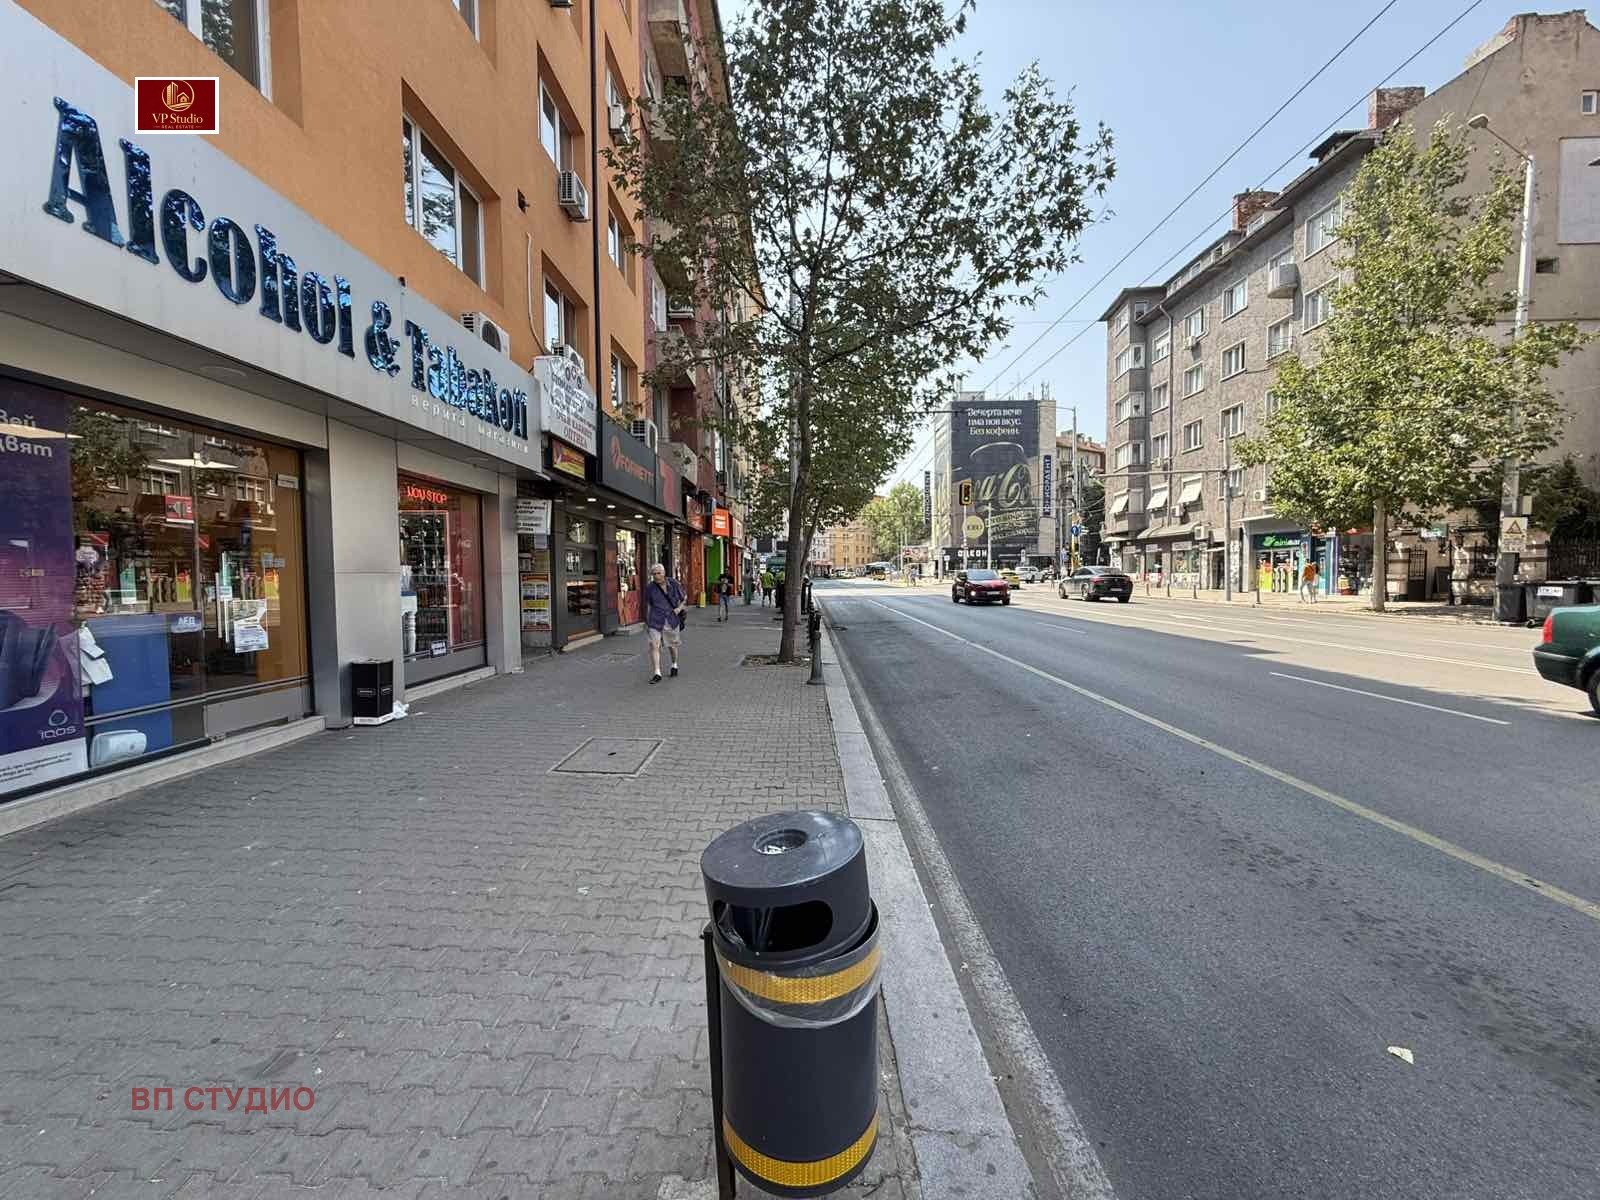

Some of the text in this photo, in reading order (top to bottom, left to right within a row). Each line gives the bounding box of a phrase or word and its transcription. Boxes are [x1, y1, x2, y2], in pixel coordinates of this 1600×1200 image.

[42, 96, 355, 359] Alcohol
[364, 301, 401, 377] &
[41, 726, 77, 739] IQOS
